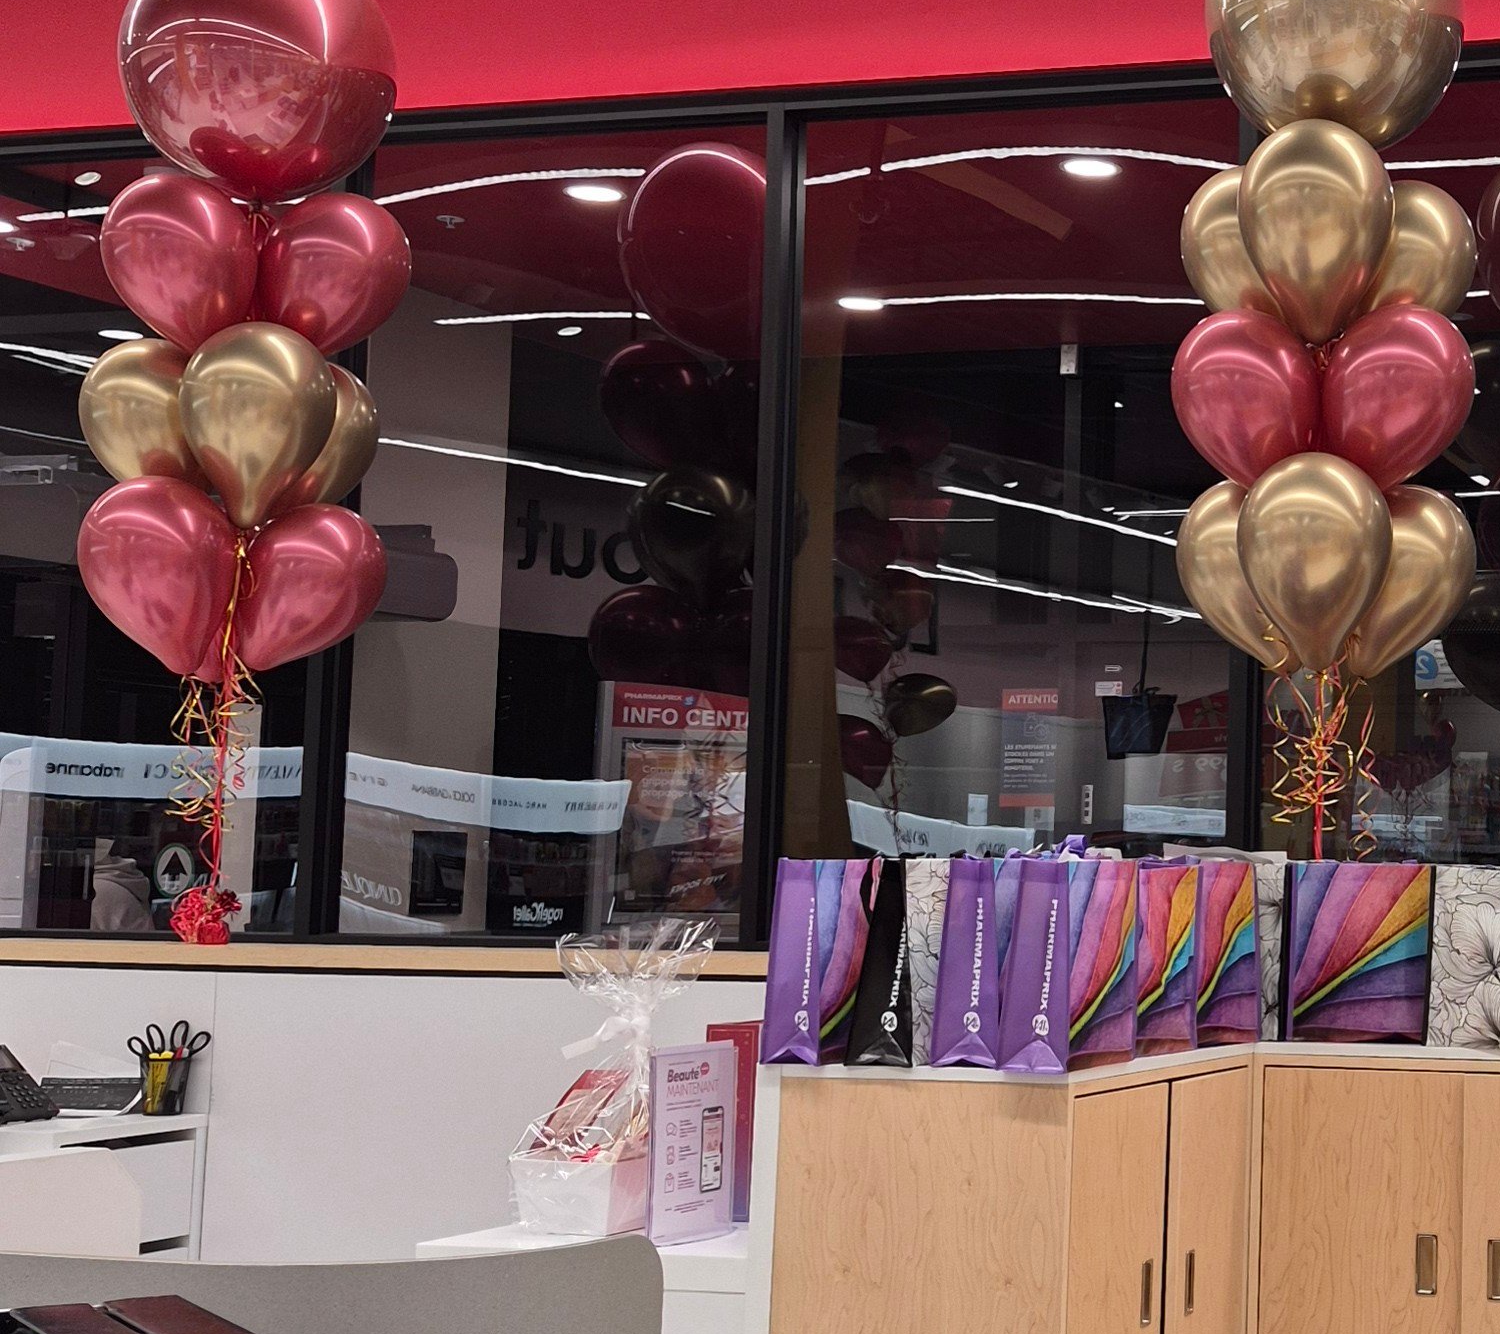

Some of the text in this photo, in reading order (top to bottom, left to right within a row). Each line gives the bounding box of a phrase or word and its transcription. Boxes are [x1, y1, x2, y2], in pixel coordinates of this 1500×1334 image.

[622, 706, 679, 725] INFO
[969, 897, 983, 1008] PHARMAPRIX
[1038, 898, 1059, 1010] PHARMAPRIX
[667, 1066, 700, 1083] Beauté
[666, 1079, 720, 1097] MAINTENANT
